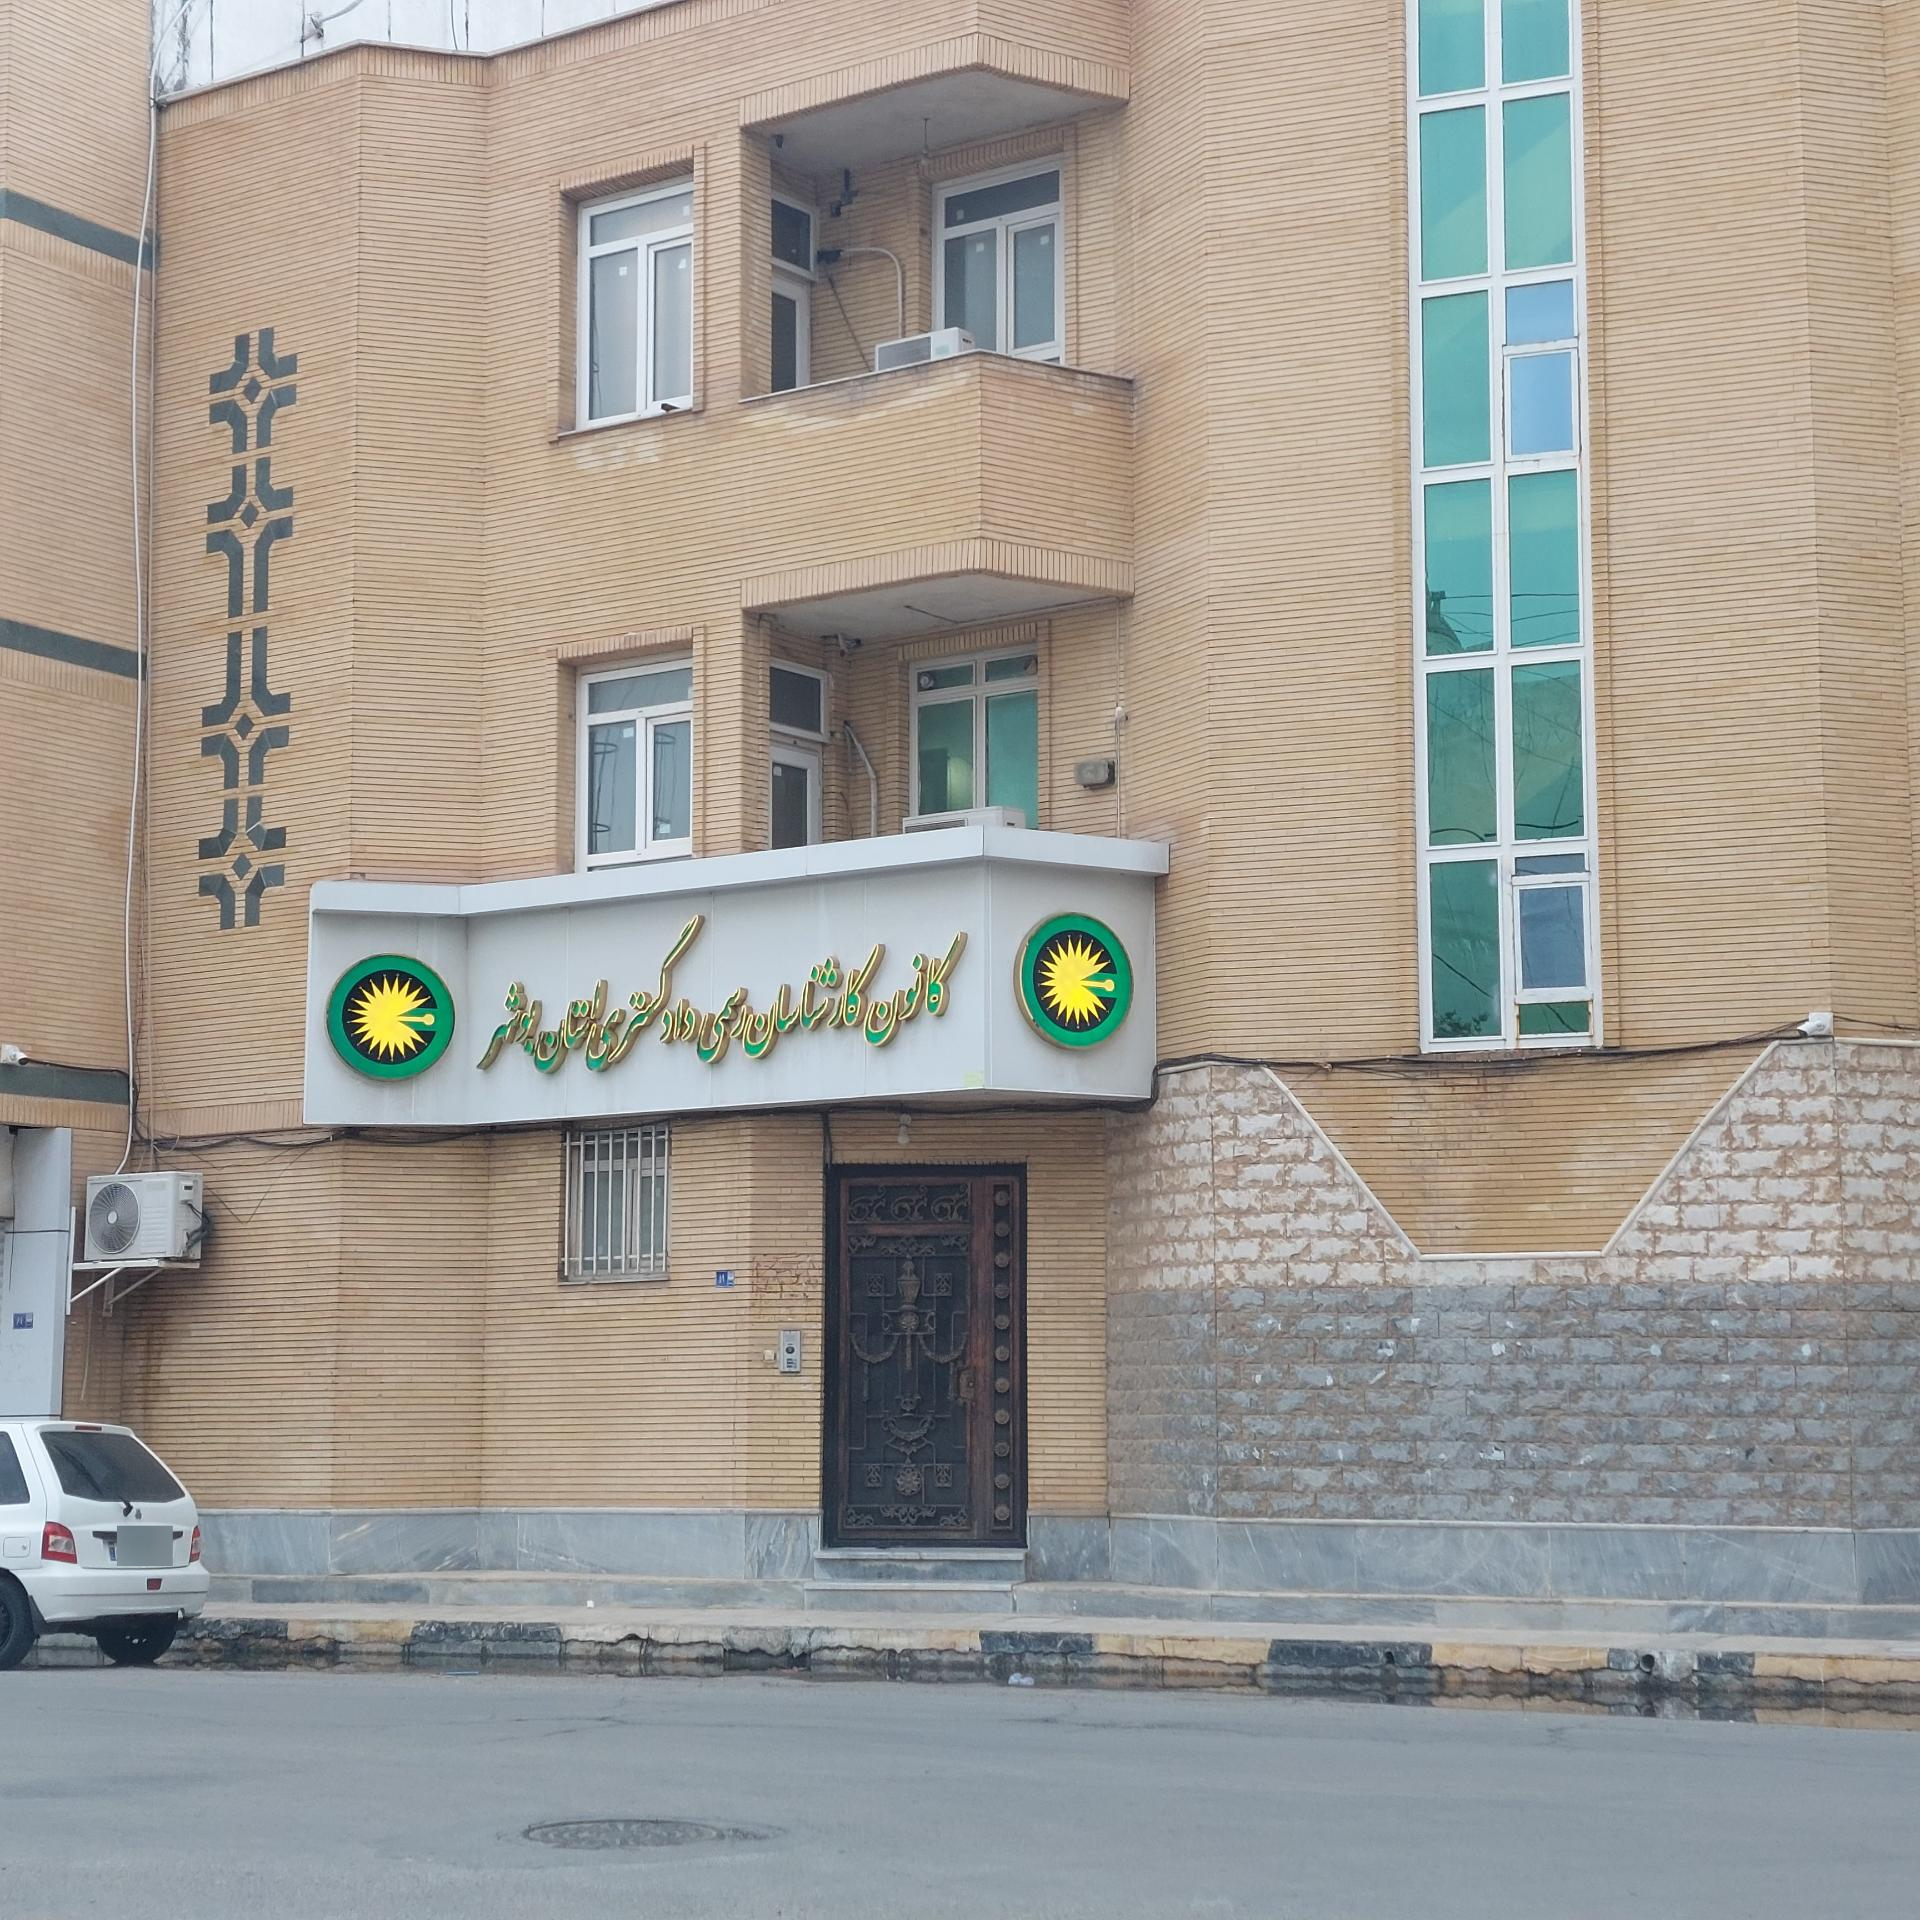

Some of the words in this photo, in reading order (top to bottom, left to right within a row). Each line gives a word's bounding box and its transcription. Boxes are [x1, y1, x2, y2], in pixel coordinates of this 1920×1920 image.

[477, 981, 543, 1071] بوشهر
[534, 979, 608, 1074] استان
[586, 914, 705, 1072] دادگستری
[696, 987, 752, 1064] رسمی
[743, 944, 886, 1059] کارشناسان
[864, 931, 968, 1047] کانون
